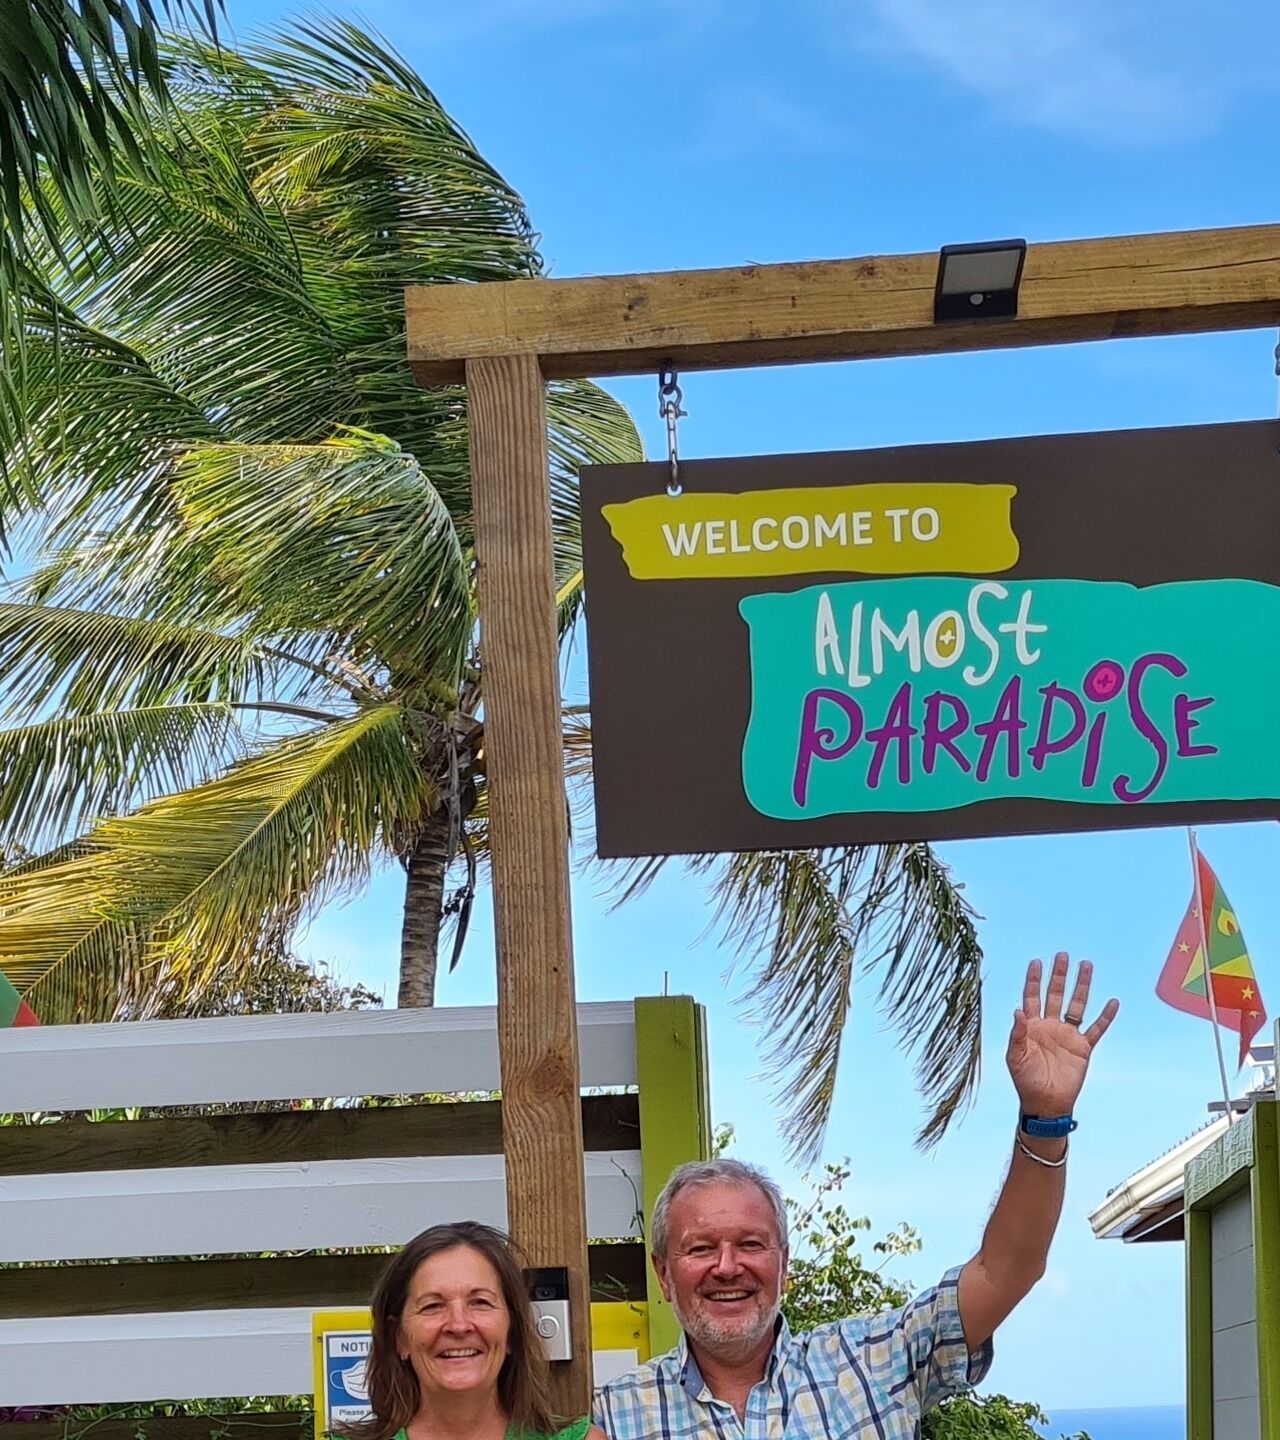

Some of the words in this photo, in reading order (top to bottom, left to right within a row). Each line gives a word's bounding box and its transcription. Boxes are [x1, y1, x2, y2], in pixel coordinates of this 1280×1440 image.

[661, 511, 874, 558] WELCOME
[884, 506, 941, 543] TO
[341, 1341, 369, 1353] NOTI
